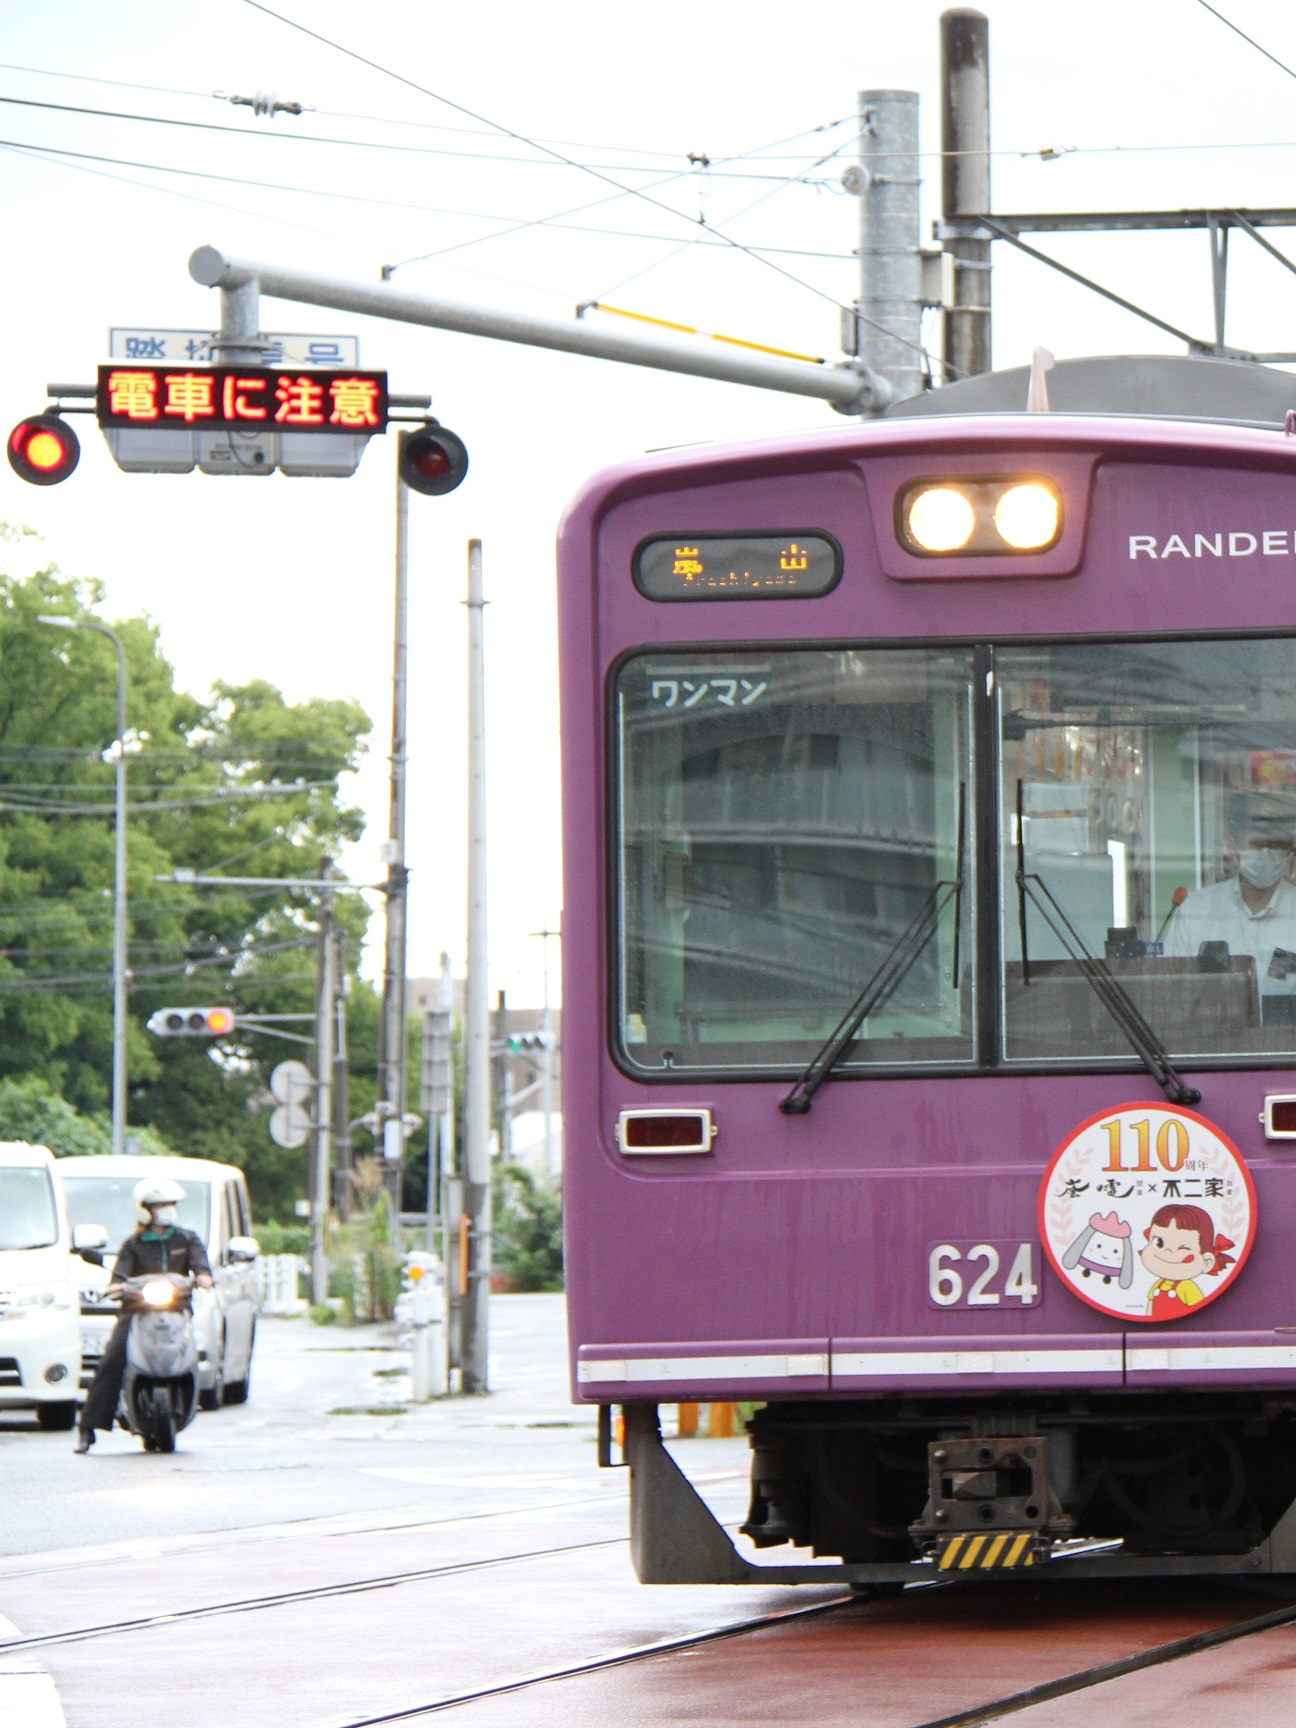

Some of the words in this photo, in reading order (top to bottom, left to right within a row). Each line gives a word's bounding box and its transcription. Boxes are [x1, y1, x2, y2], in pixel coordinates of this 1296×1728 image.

[108, 370, 379, 426] 電車に注意
[652, 680, 767, 708] ワンマン
[1162, 1178, 1224, 1198] 不二家
[929, 1243, 1038, 1306] 624
